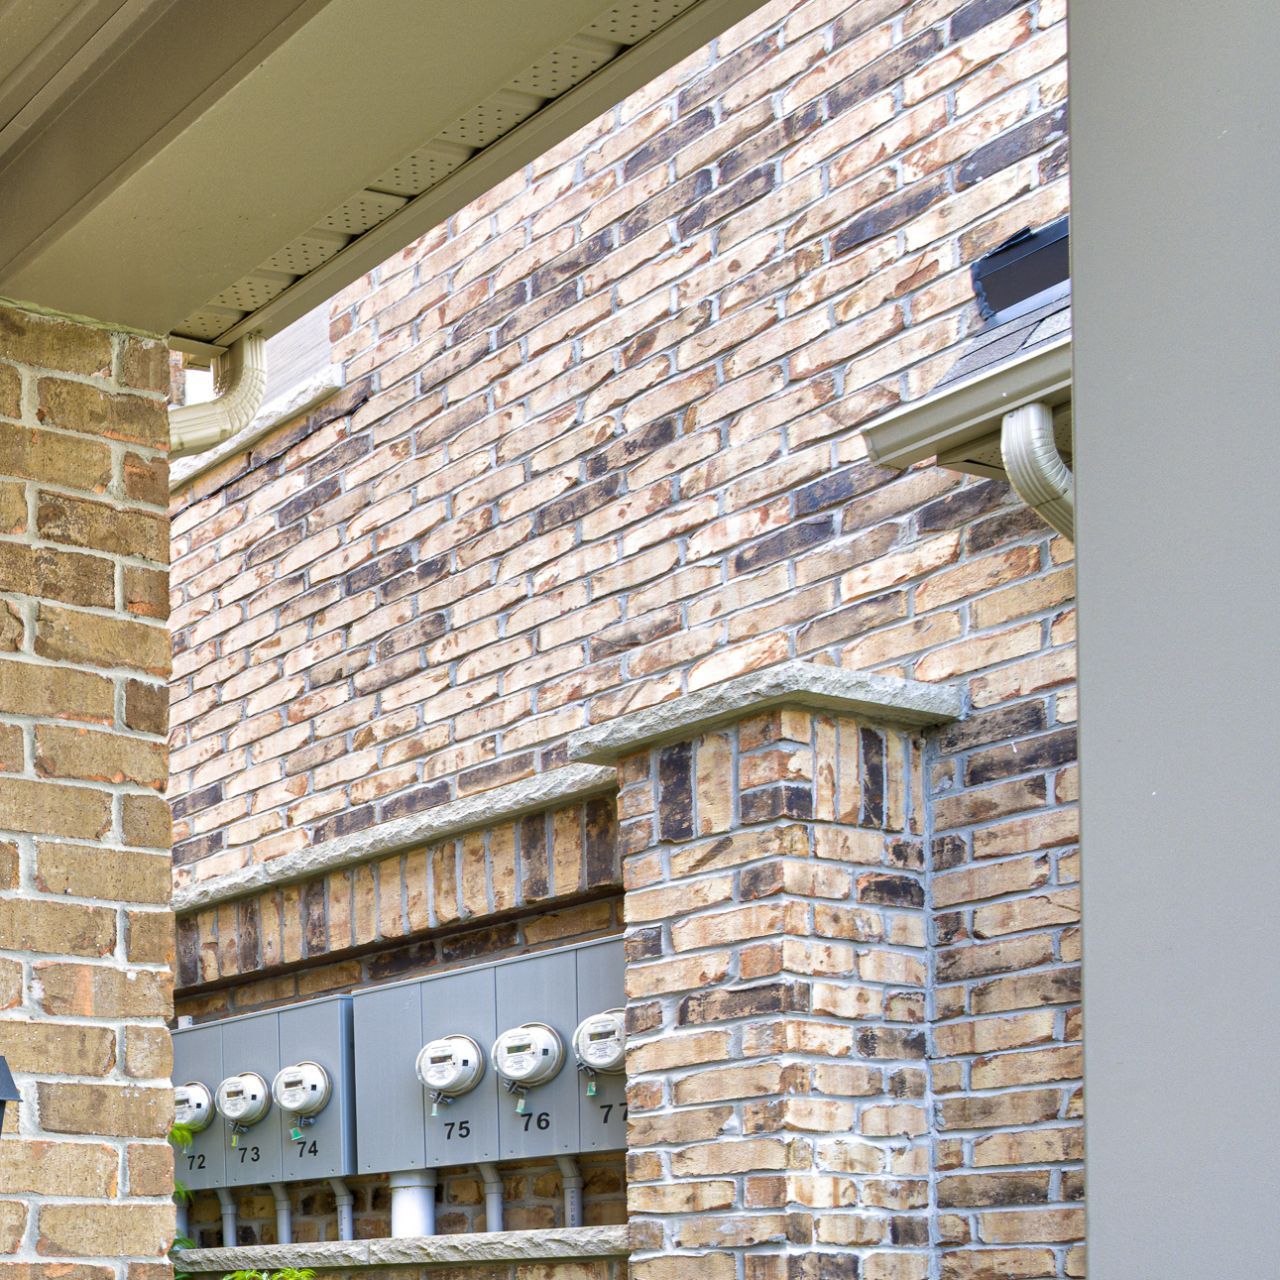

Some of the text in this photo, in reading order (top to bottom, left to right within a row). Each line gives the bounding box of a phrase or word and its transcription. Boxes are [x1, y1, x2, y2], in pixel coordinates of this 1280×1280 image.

[444, 1120, 471, 1140] 75
[520, 1112, 550, 1132] 76
[238, 1146, 261, 1163] 73
[296, 1140, 319, 1157] 74
[187, 1153, 207, 1170] 72
